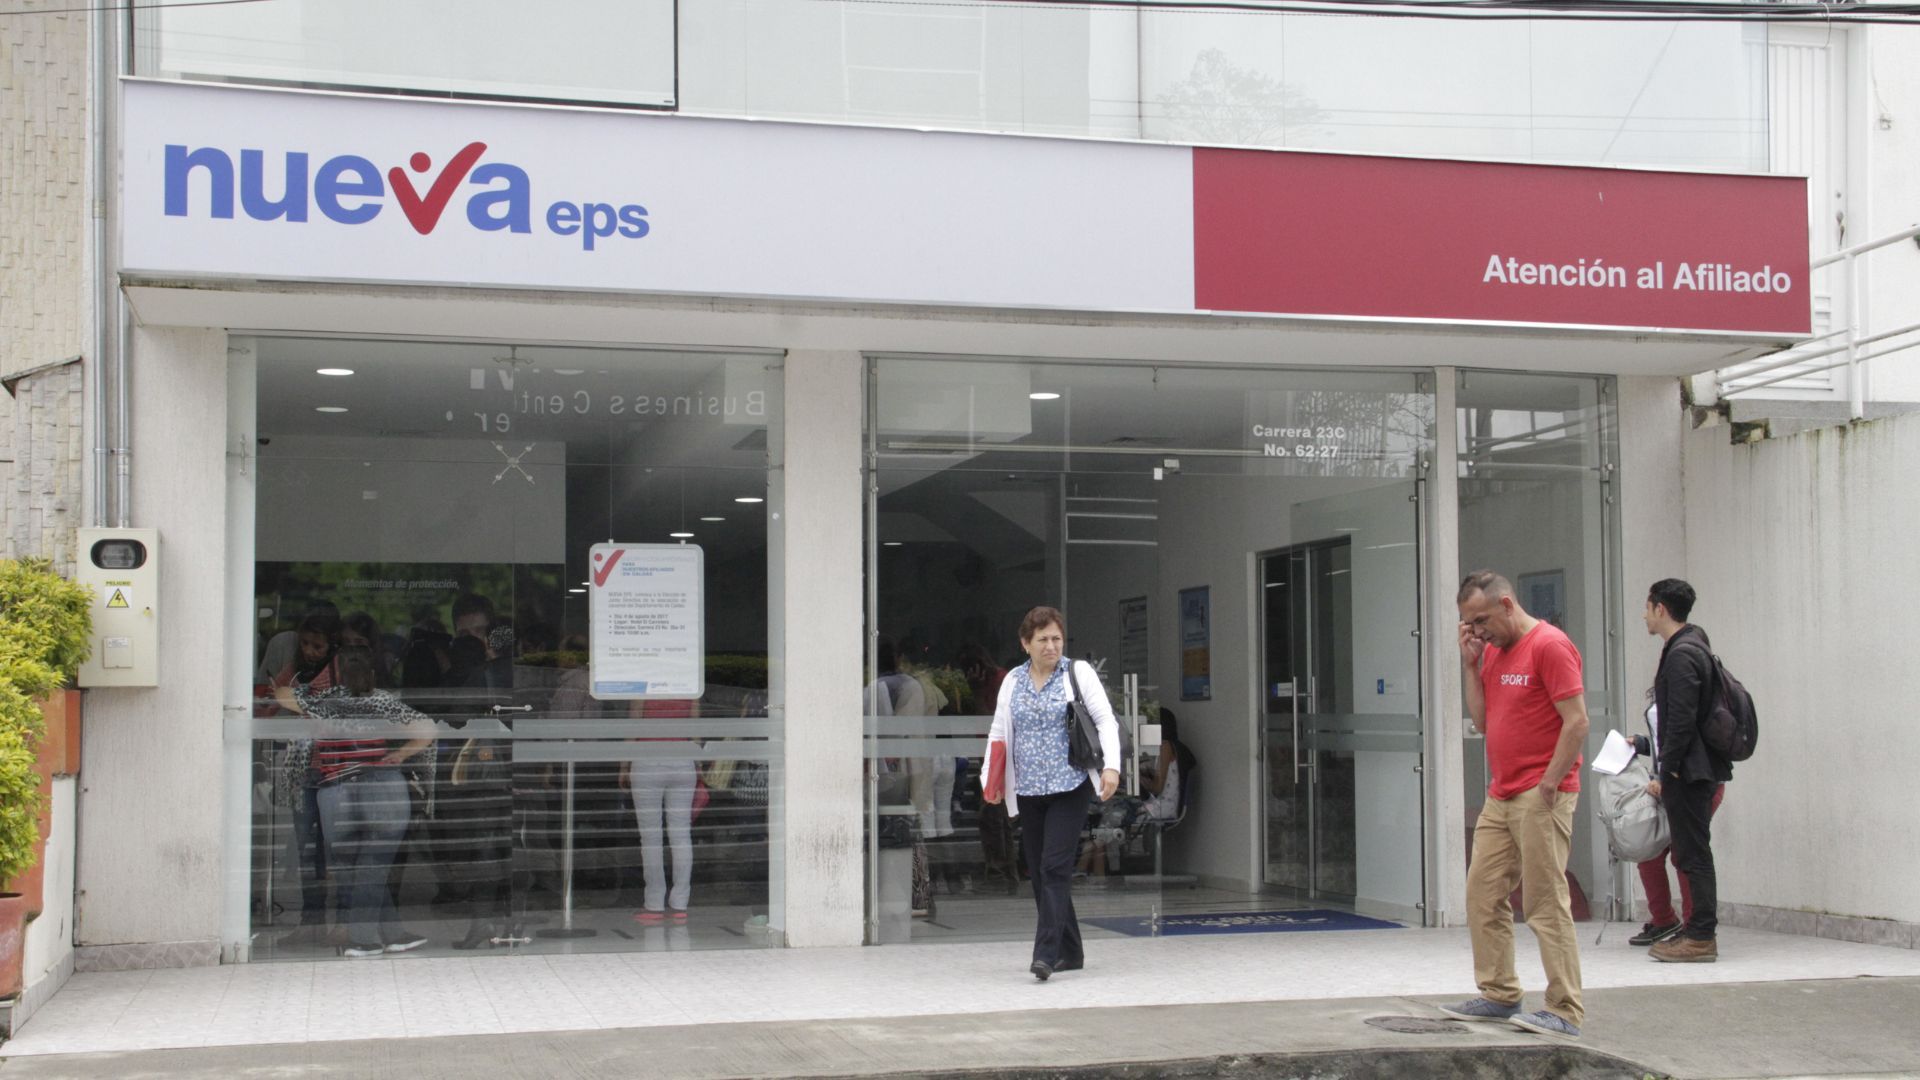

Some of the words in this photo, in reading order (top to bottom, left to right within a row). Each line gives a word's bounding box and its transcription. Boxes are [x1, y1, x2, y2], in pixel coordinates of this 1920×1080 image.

[164, 143, 530, 236] nueva
[547, 201, 648, 250] eps
[1483, 255, 1628, 288] Atención
[1637, 261, 1663, 290] al
[1673, 262, 1794, 294] Afiliado
[1253, 424, 1312, 438] Carrera
[1316, 426, 1345, 440] 23C
[1264, 443, 1291, 457] No.
[1295, 444, 1339, 458] 62-27
[395, 579, 407, 589] de
